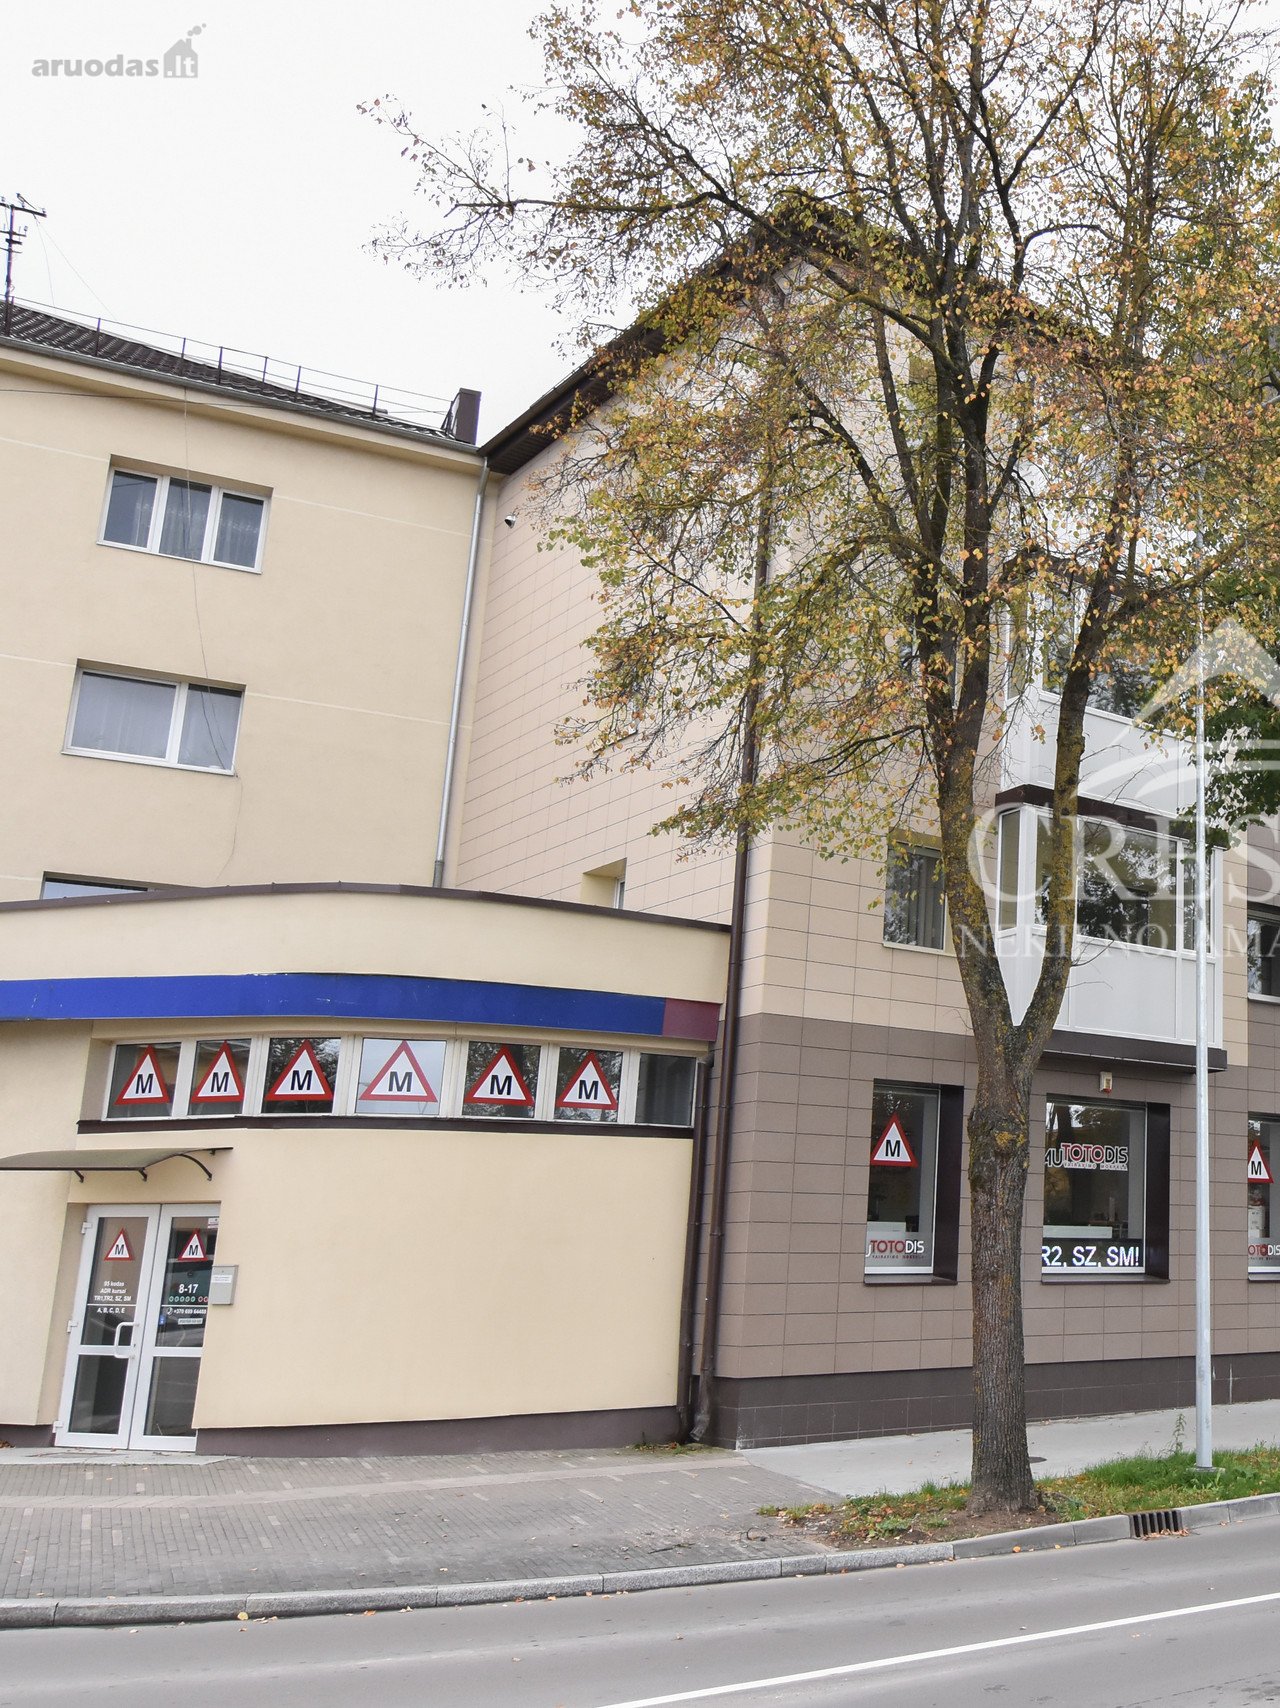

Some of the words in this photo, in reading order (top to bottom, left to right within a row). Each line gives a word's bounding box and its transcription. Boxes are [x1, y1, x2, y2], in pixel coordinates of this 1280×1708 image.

[135, 1073, 154, 1094] M
[211, 1071, 230, 1093] M
[290, 1070, 313, 1091] M
[388, 1071, 413, 1092] M
[489, 1074, 513, 1096] M
[577, 1079, 600, 1100] M
[885, 1139, 901, 1158] M
[1251, 1160, 1262, 1175] M
[114, 1244, 125, 1255] M
[188, 1245, 199, 1256] M
[1072, 1246, 1102, 1267] SZ,
[1106, 1246, 1139, 1266] SM!
[178, 1283, 199, 1294] 8-17
